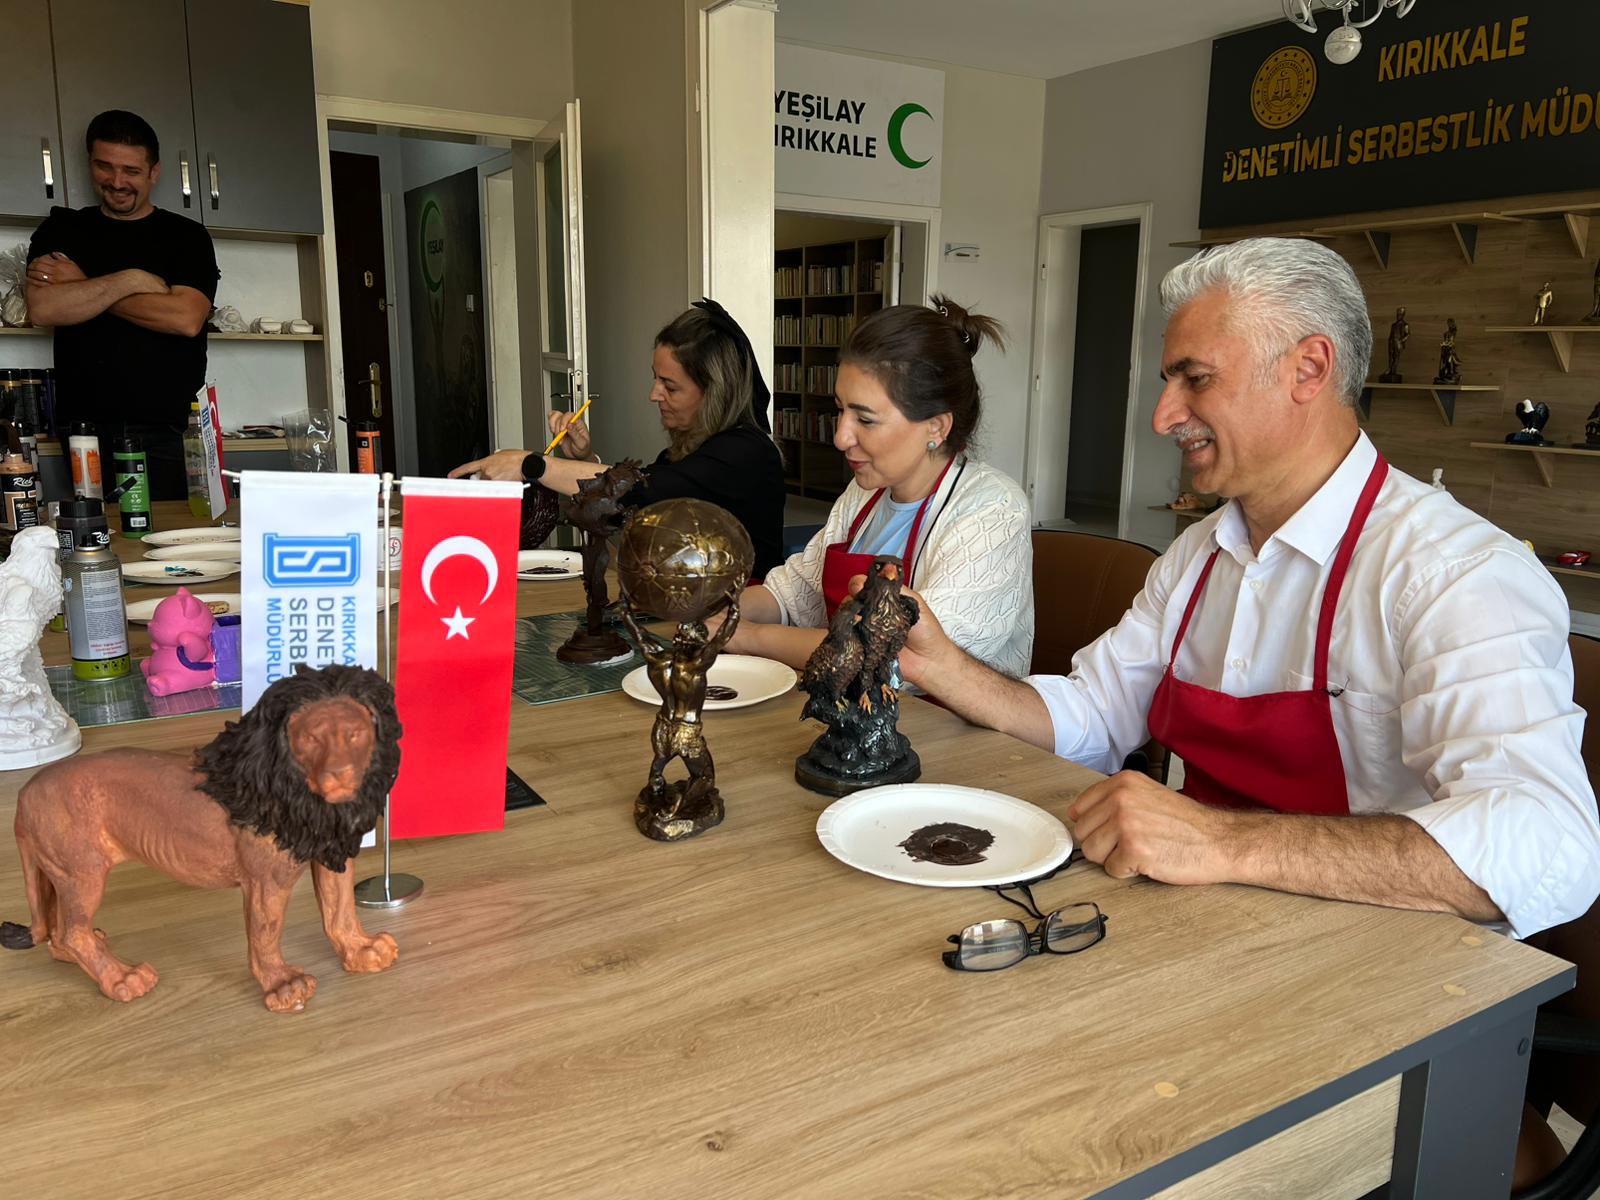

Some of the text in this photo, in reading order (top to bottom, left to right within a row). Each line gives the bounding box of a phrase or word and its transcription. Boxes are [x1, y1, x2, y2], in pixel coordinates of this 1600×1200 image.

[1378, 15, 1529, 82] KIRIKKALE
[1222, 86, 1600, 184] DENETİMLİ SERBESTLİK MÜD
